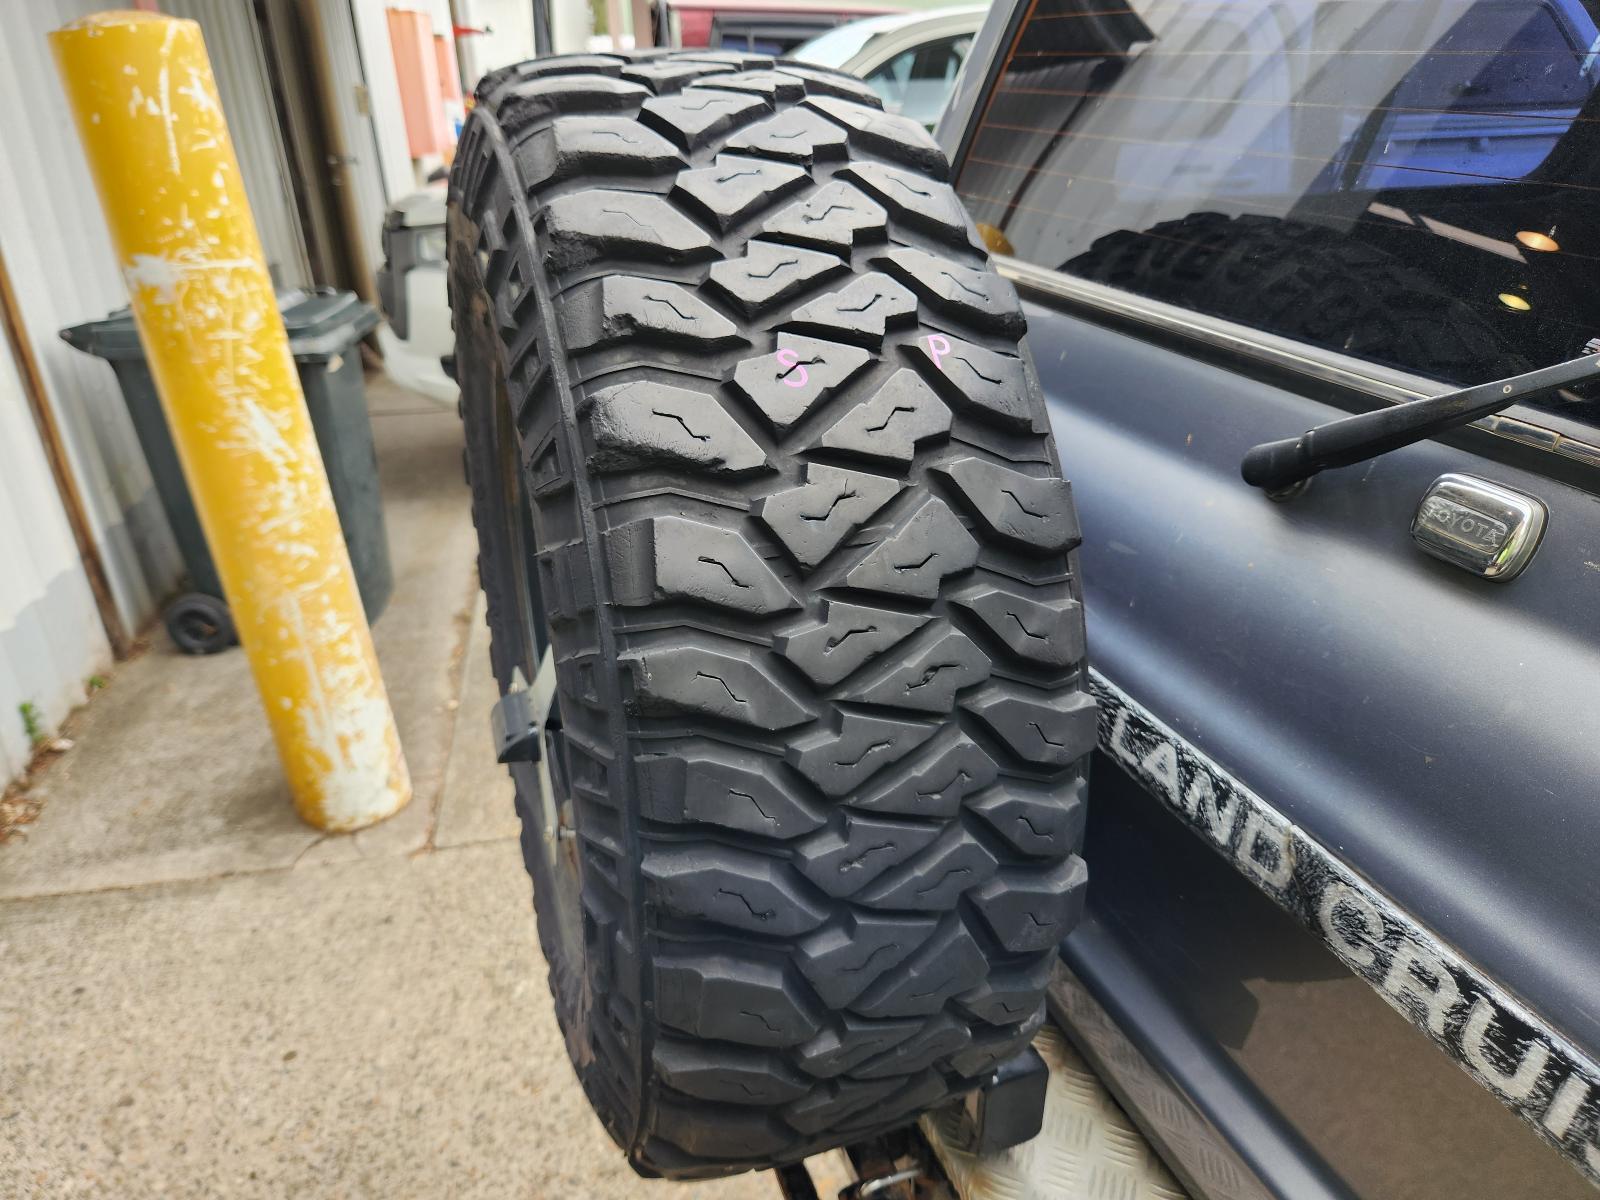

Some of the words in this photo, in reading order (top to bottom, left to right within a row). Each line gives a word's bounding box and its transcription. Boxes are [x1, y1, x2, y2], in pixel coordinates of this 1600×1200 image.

[777, 349, 809, 388] S
[927, 335, 951, 369] P
[1429, 509, 1499, 547] TOYOTA
[1110, 708, 1295, 889] LAND
[1319, 882, 1600, 1187] CRUI
